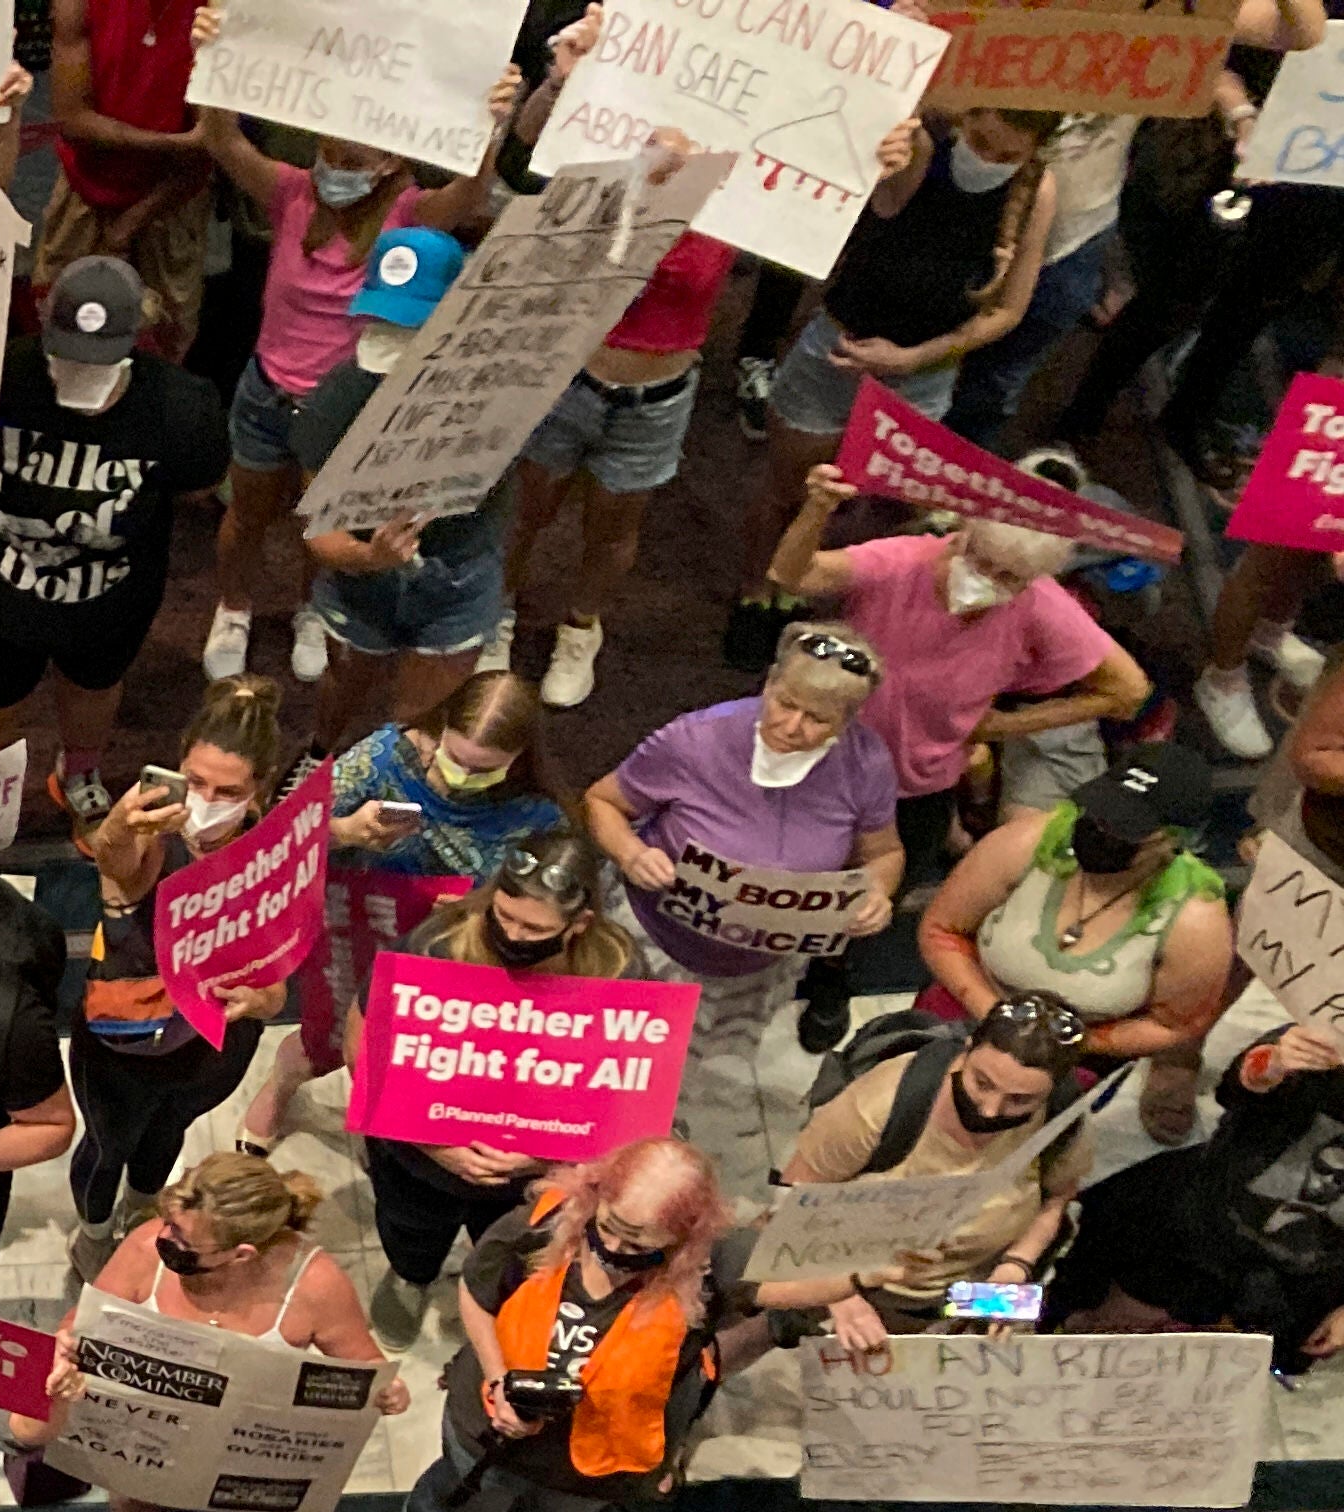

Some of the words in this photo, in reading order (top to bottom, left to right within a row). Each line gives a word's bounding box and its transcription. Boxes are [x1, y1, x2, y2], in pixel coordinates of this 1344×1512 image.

[304, 27, 414, 82] MORE
[595, 11, 682, 75] BAN
[674, 43, 769, 116] SAFE
[827, 20, 941, 92] ONLY
[207, 50, 332, 119] RIGHTS
[352, 95, 419, 142] THAN
[2, 426, 159, 502] Valley
[168, 831, 292, 929] Together
[293, 802, 324, 846] We
[682, 843, 745, 883] MY
[172, 909, 251, 975] Fight
[257, 882, 291, 928] for
[293, 842, 320, 898] All
[667, 877, 730, 914] MY
[736, 883, 866, 912] BODY
[663, 899, 845, 954] CHOICE!
[392, 983, 592, 1041] Together
[598, 1008, 670, 1044] We
[392, 1035, 506, 1083] Fight
[515, 1050, 578, 1083] for
[589, 1057, 651, 1092] All
[446, 1105, 501, 1126] Planned
[503, 1112, 591, 1135] Parenthood
[81, 1340, 224, 1391] NOVEMBER
[97, 1361, 204, 1402] COMING
[1053, 1340, 1262, 1378] RIGHTS
[84, 1391, 180, 1425] NEVER
[810, 1385, 968, 1412] SHOULD
[67, 1434, 164, 1469] AGAIN
